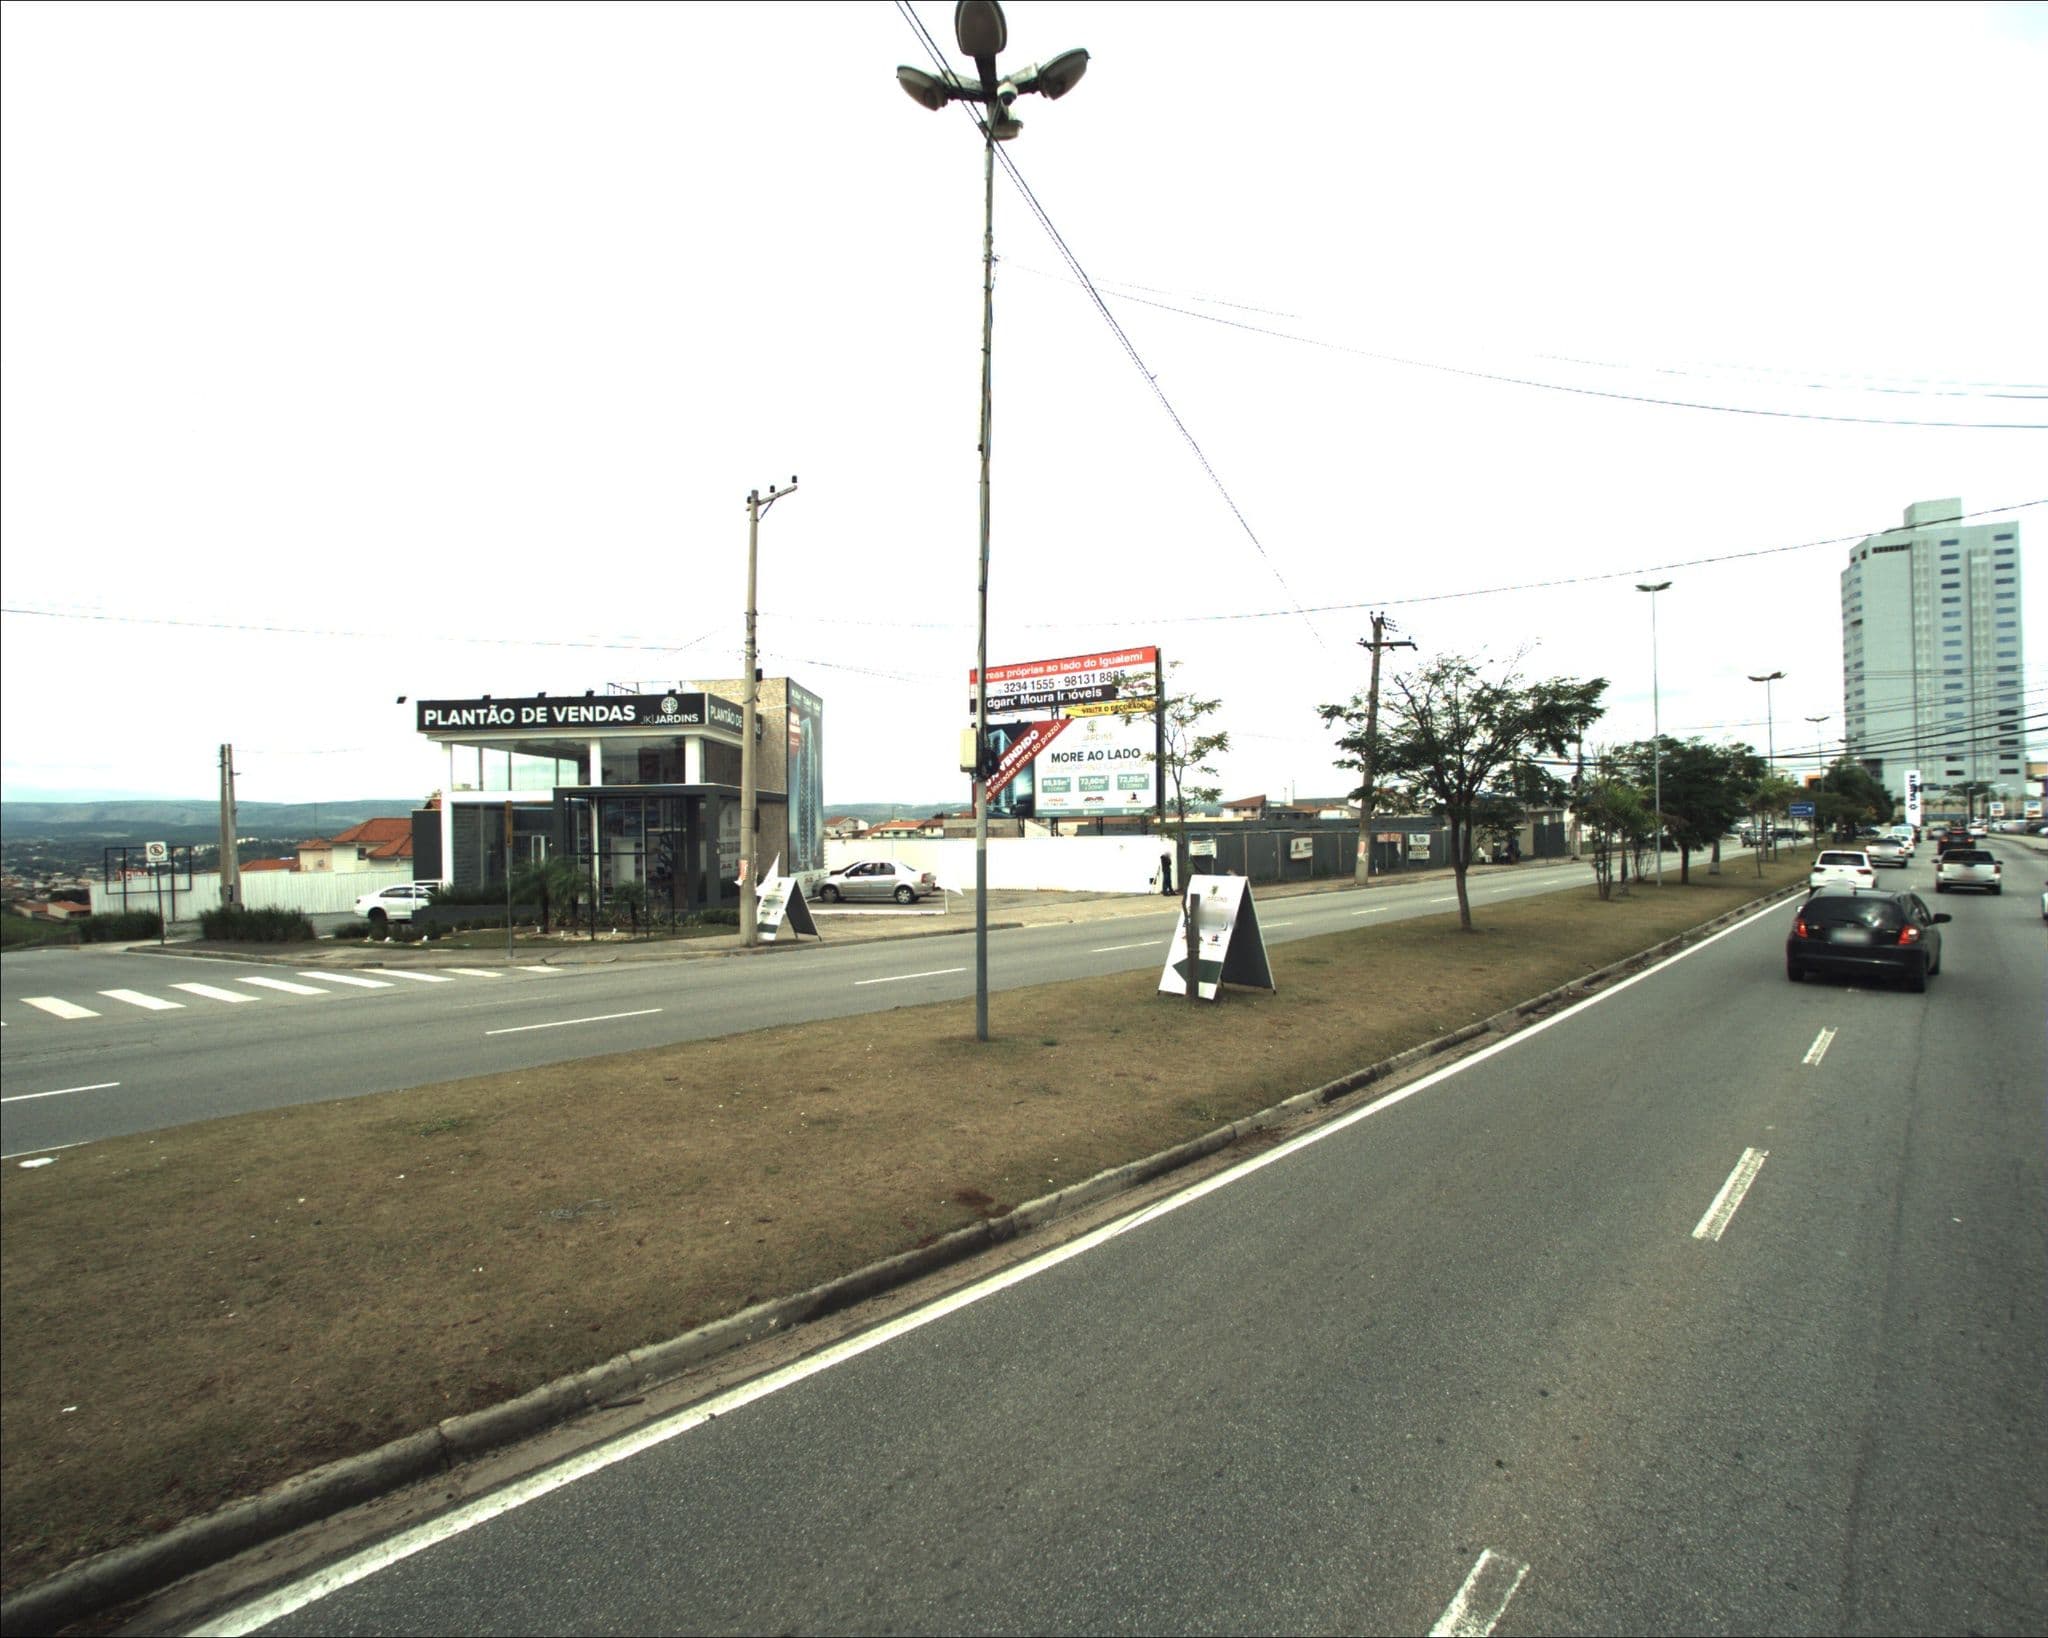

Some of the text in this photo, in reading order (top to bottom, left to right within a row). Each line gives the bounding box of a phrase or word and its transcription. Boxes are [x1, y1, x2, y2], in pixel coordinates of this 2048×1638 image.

[1084, 658, 1097, 667] do
[1099, 651, 1143, 667] Iguatemi
[1003, 680, 1027, 693] 3234
[1031, 678, 1055, 690] 1555
[1064, 673, 1096, 686] 98131
[1020, 693, 1054, 704] Moura
[424, 704, 636, 726] PLANTÃO DE VENDAS
[655, 713, 699, 724] JARDINS
[1032, 742, 1041, 753] do
[1051, 747, 1141, 763] MORE AO LADO
